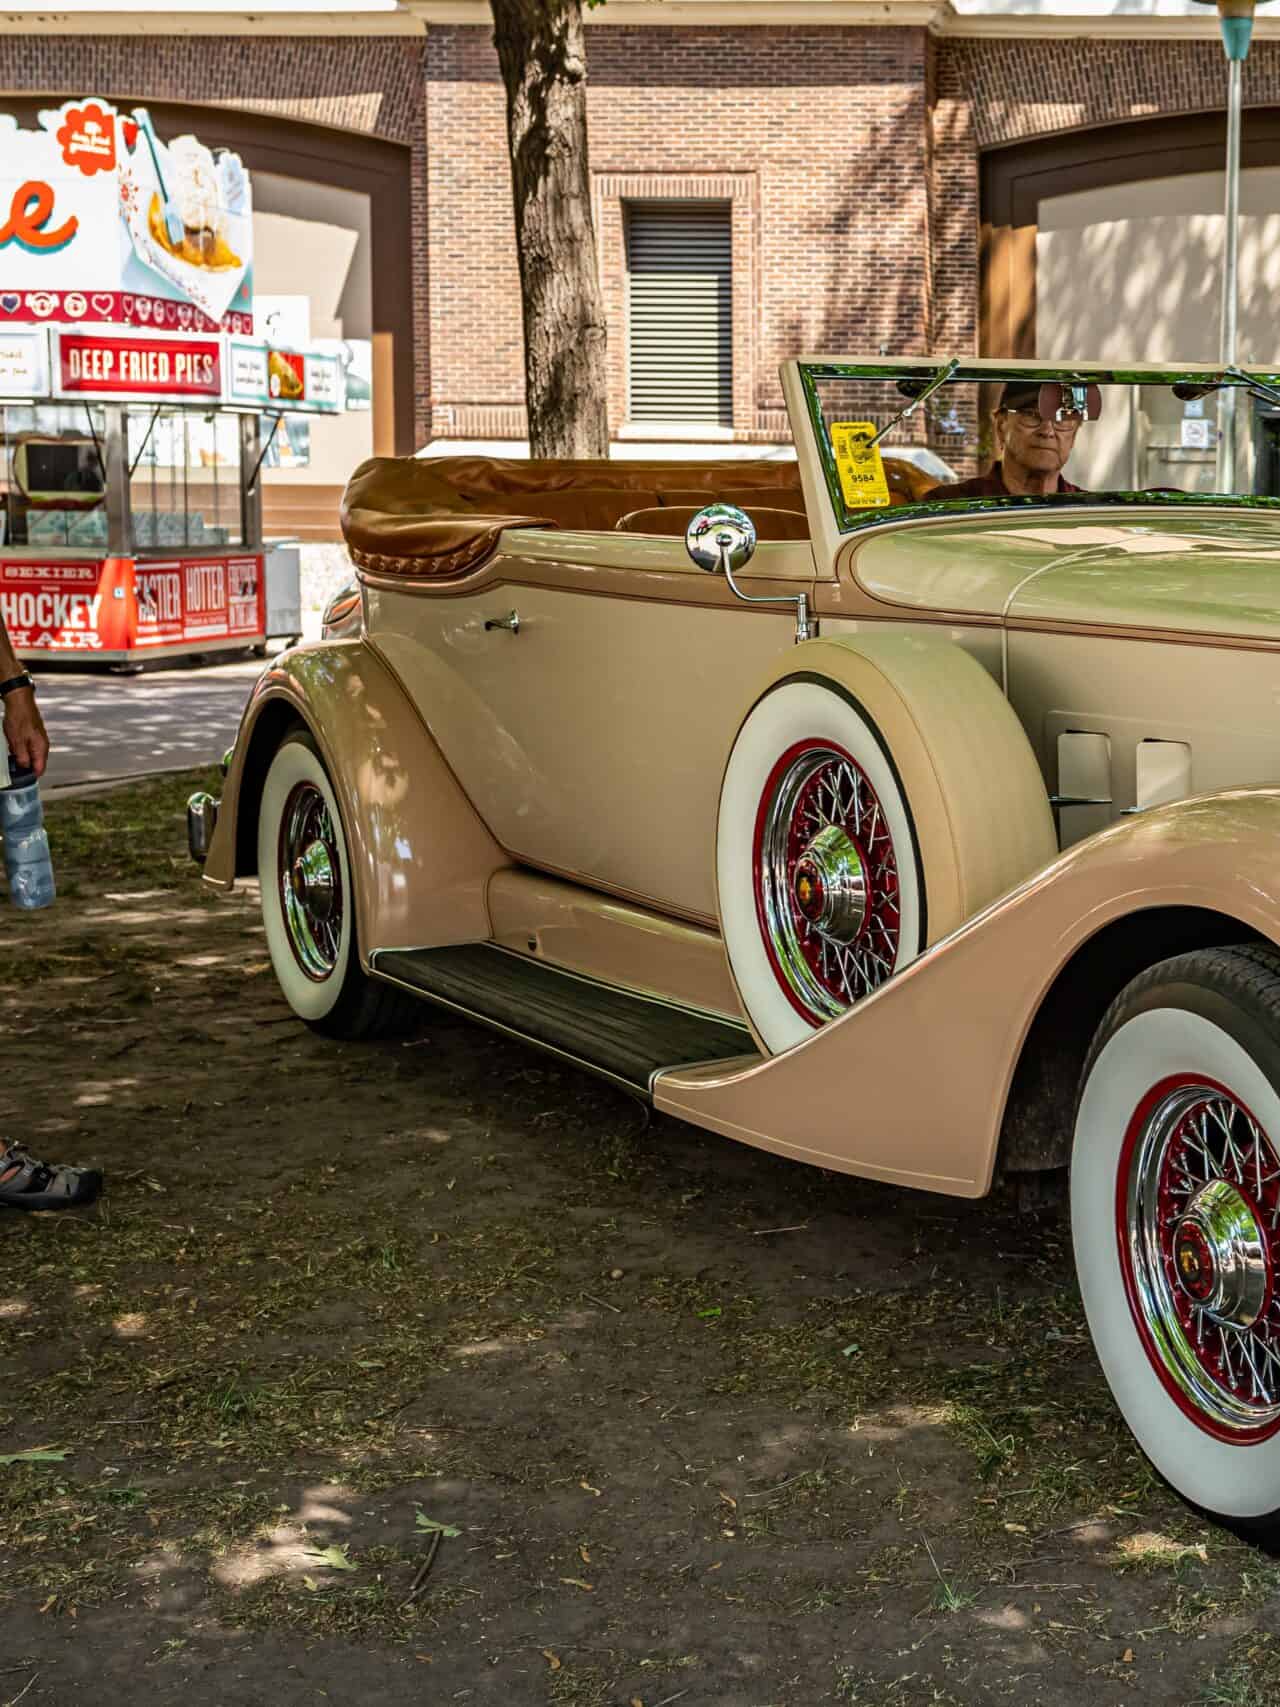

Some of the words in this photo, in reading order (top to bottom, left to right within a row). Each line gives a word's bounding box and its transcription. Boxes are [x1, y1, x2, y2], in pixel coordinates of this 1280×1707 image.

[69, 348, 114, 381] DEEP
[119, 350, 170, 383] FRIED
[175, 352, 214, 384] PIES
[852, 474, 874, 482] 9584
[4, 566, 94, 579] SEXIER
[185, 565, 225, 612] HOTTER
[0, 592, 103, 629] HOCKEY
[135, 572, 182, 622] TASTIER
[8, 630, 103, 649] HAIR
